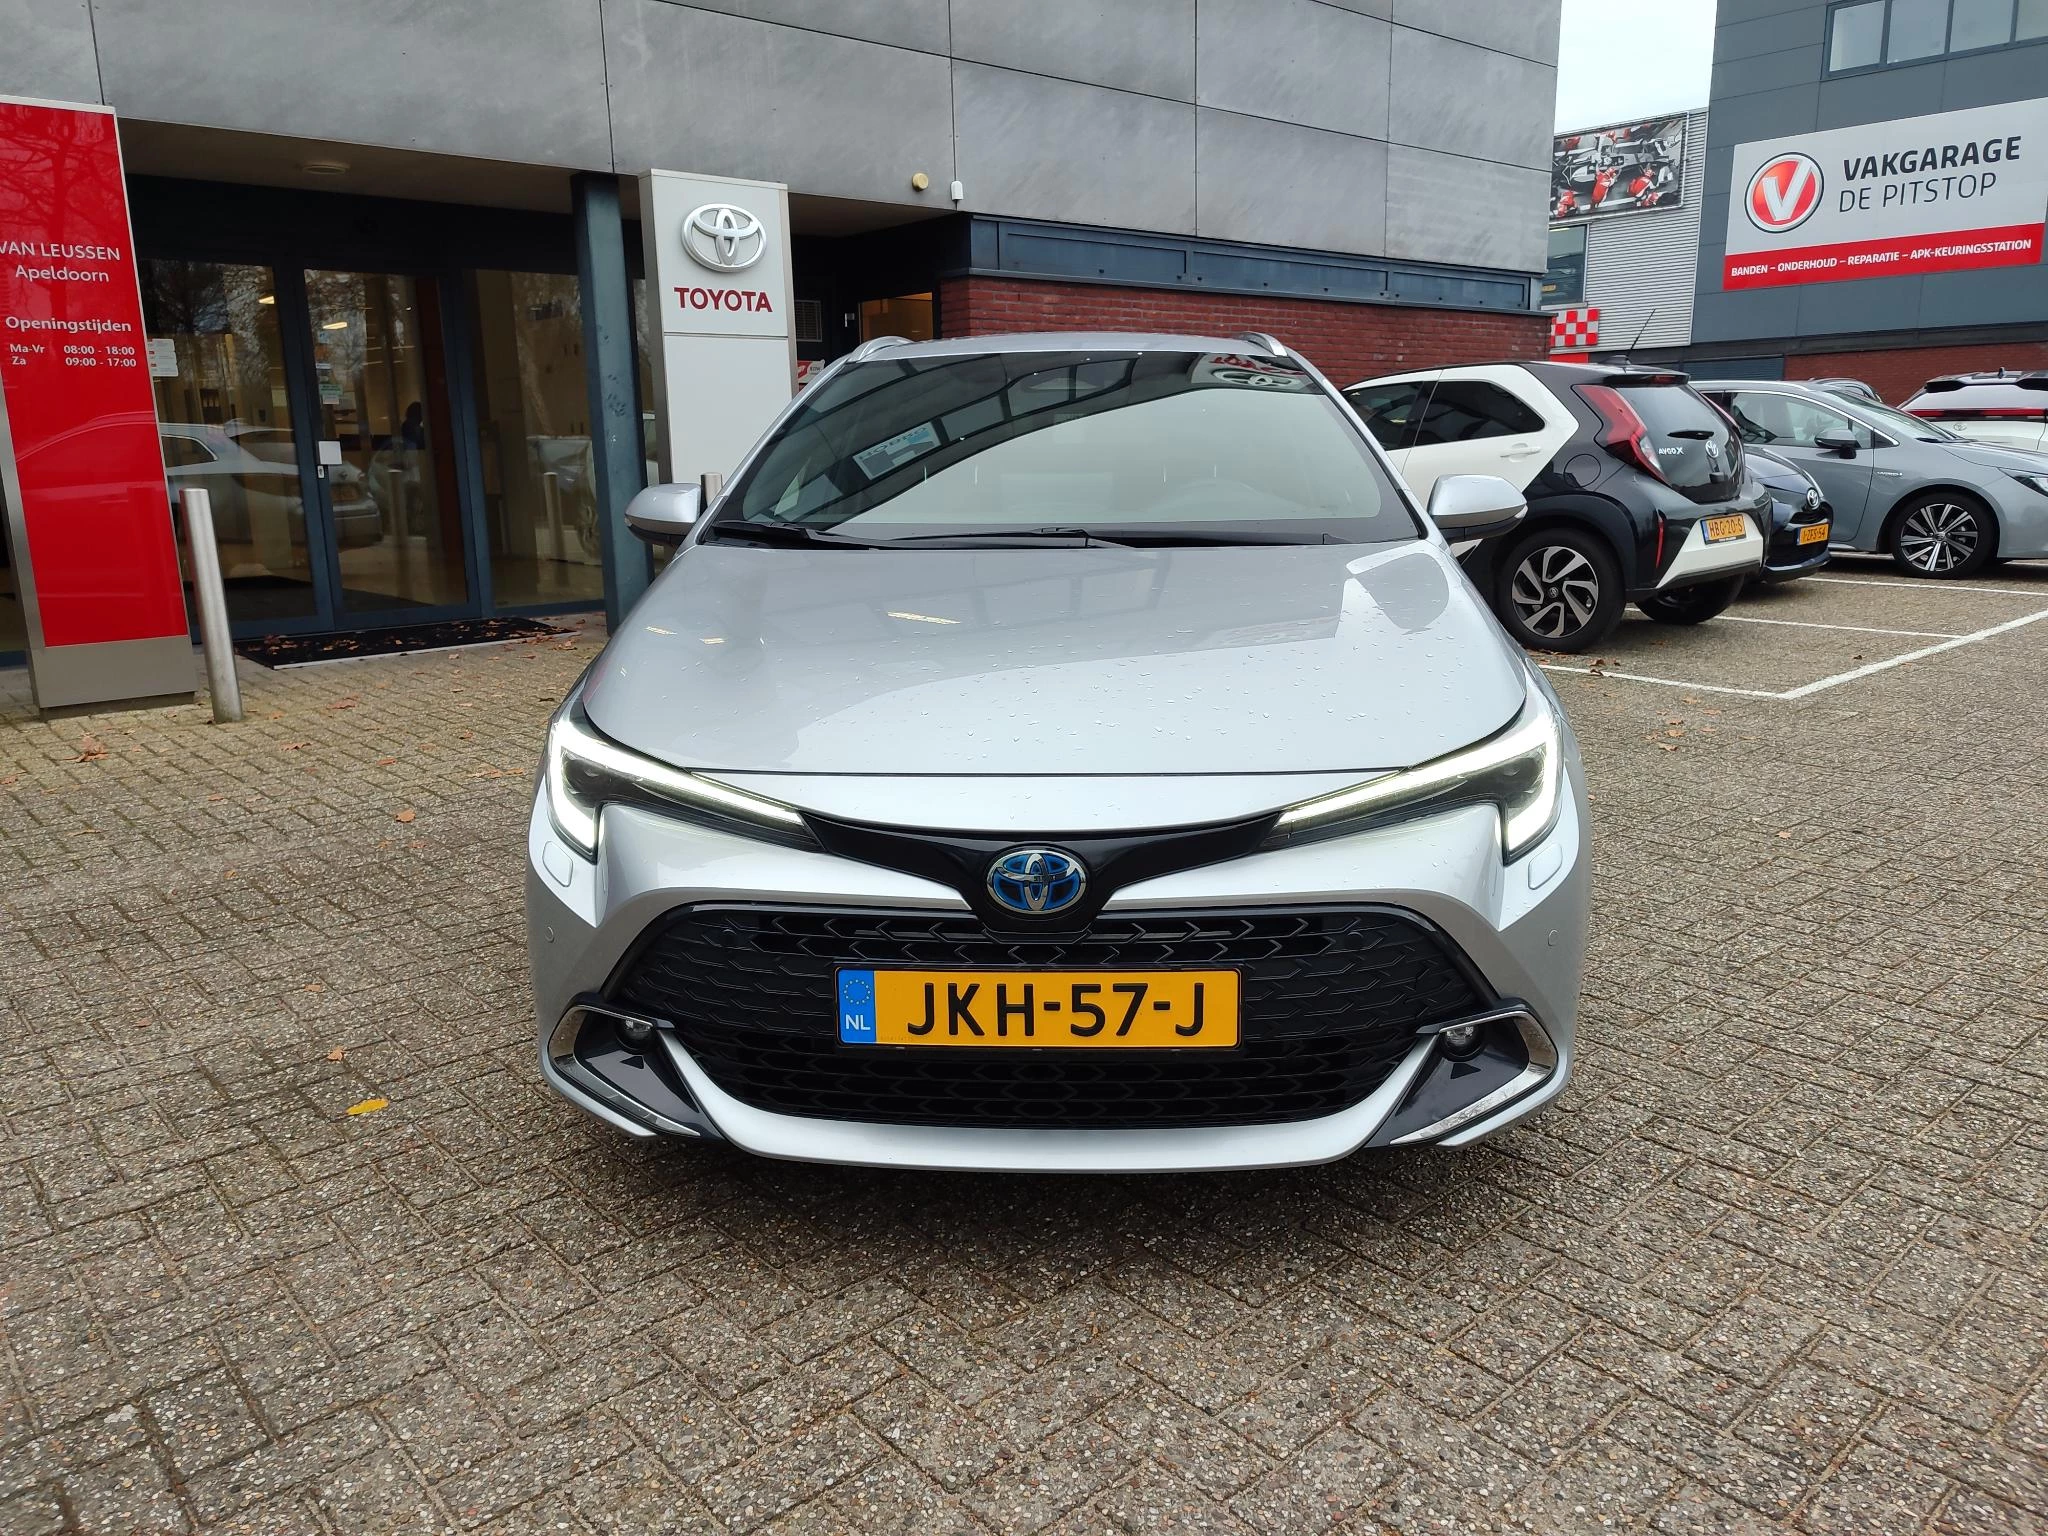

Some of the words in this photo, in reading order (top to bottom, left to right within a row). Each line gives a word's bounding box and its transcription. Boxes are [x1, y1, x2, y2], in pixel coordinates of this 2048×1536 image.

[1843, 135, 2022, 182] VAKGARAGE
[1839, 187, 1872, 213] DE
[1883, 172, 1997, 208] PITSTOP
[0, 241, 36, 256] VAN
[40, 242, 121, 261] LEUSSEN
[1731, 264, 1768, 277] BANDEN
[1777, 257, 1837, 272] ONDERHOUD
[1847, 250, 1900, 265] REPARATIE
[1910, 238, 2032, 259] APK-KEURINGSSTATION
[15, 264, 110, 282] Apeldoorn
[673, 286, 773, 313] TOYOTA
[5, 316, 132, 335] Openingstijden
[9, 344, 46, 354] Ma-Vr
[63, 345, 95, 355] 08:00
[105, 345, 135, 356] 18:00
[11, 356, 27, 366] Za
[65, 357, 97, 367] 09:00
[107, 358, 137, 368] 17:00
[845, 1014, 871, 1031] NL
[907, 982, 1205, 1037] JKH-57-J
